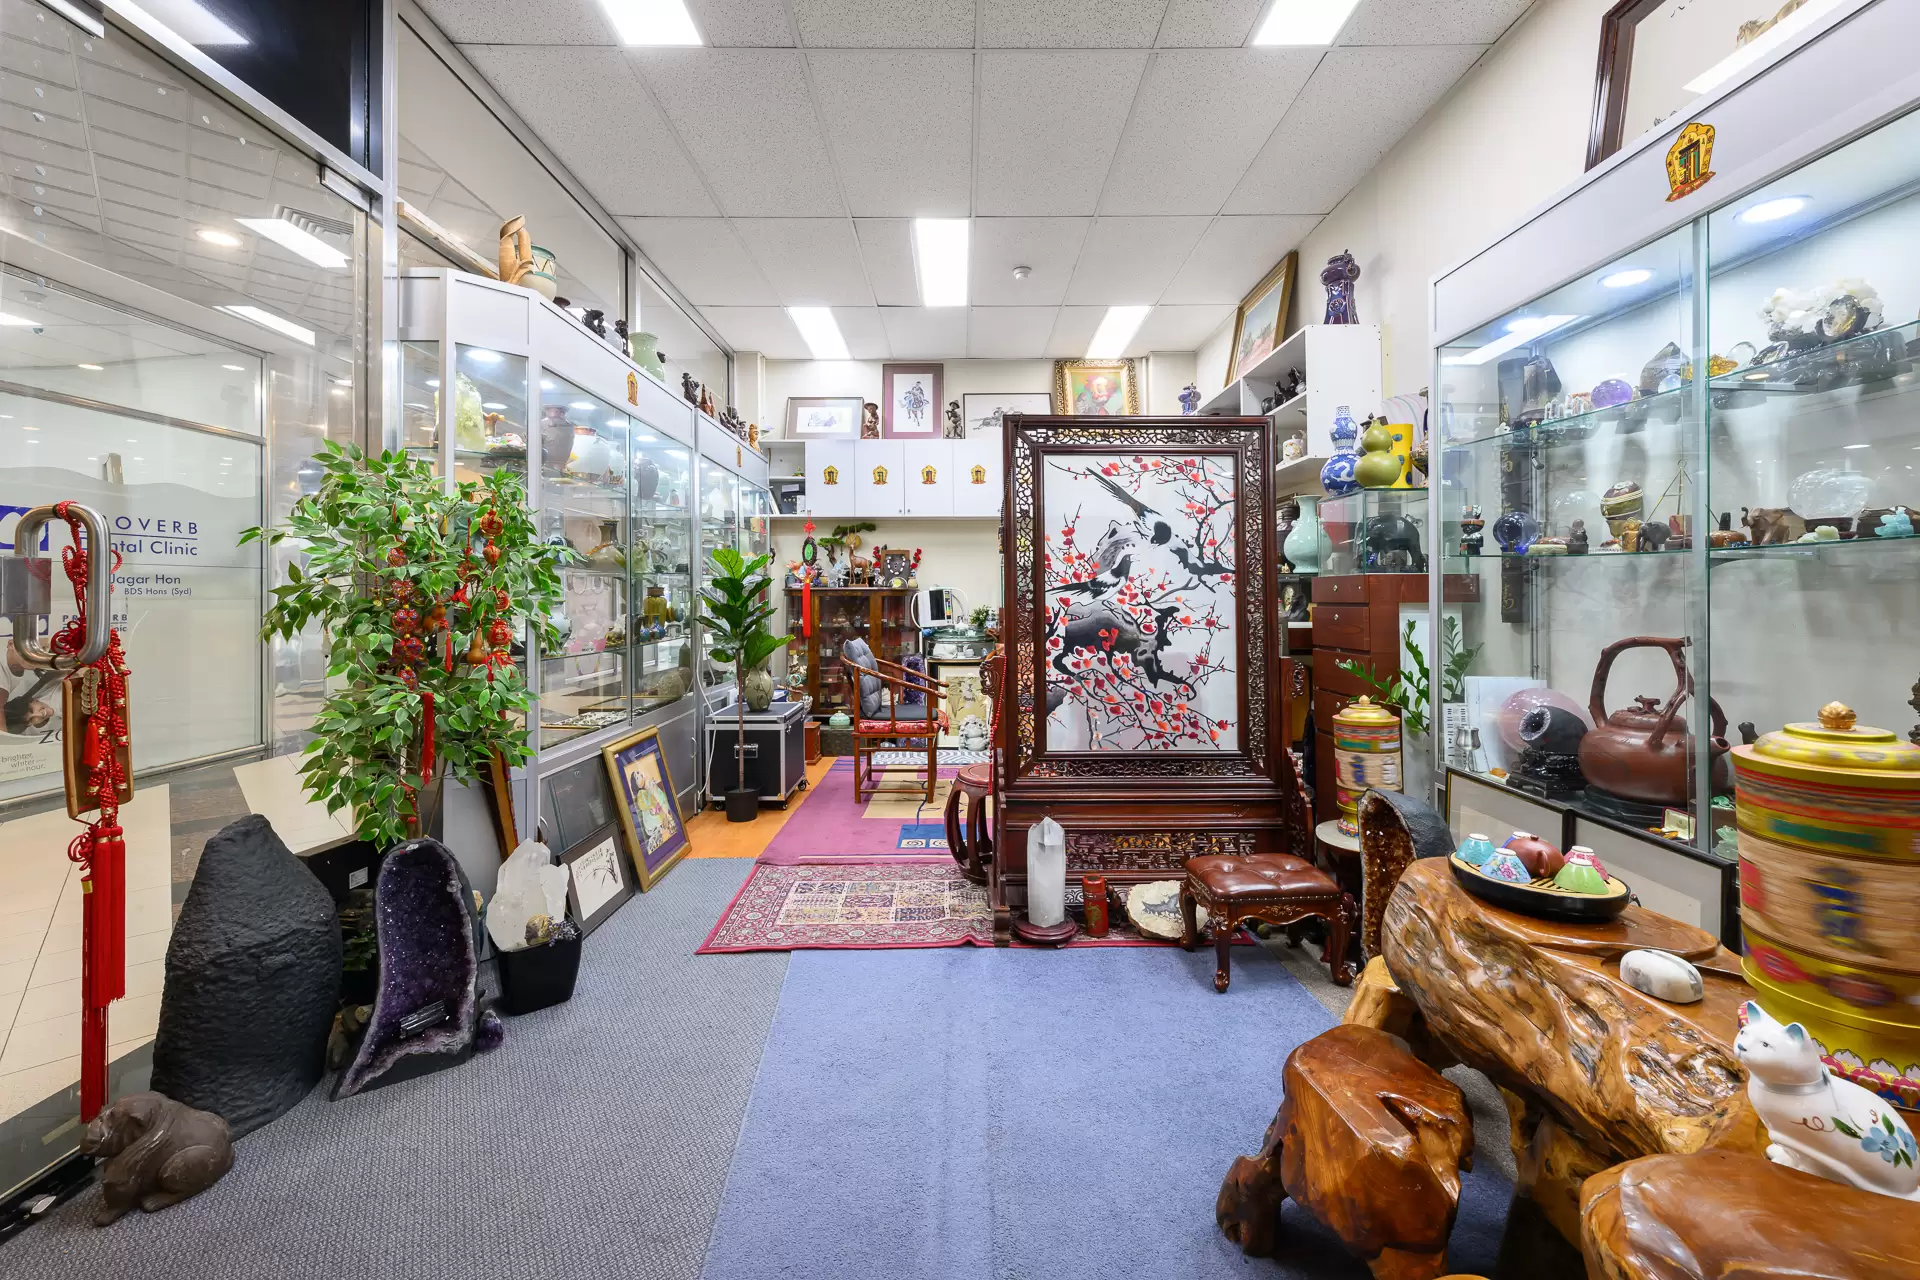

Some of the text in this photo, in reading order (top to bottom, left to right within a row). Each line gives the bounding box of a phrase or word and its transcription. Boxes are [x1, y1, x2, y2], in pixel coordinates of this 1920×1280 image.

[115, 516, 198, 535] OVERB
[80, 537, 198, 556] Dntal Clinic
[155, 574, 181, 584] Hon
[171, 587, 192, 597] (Syd)
